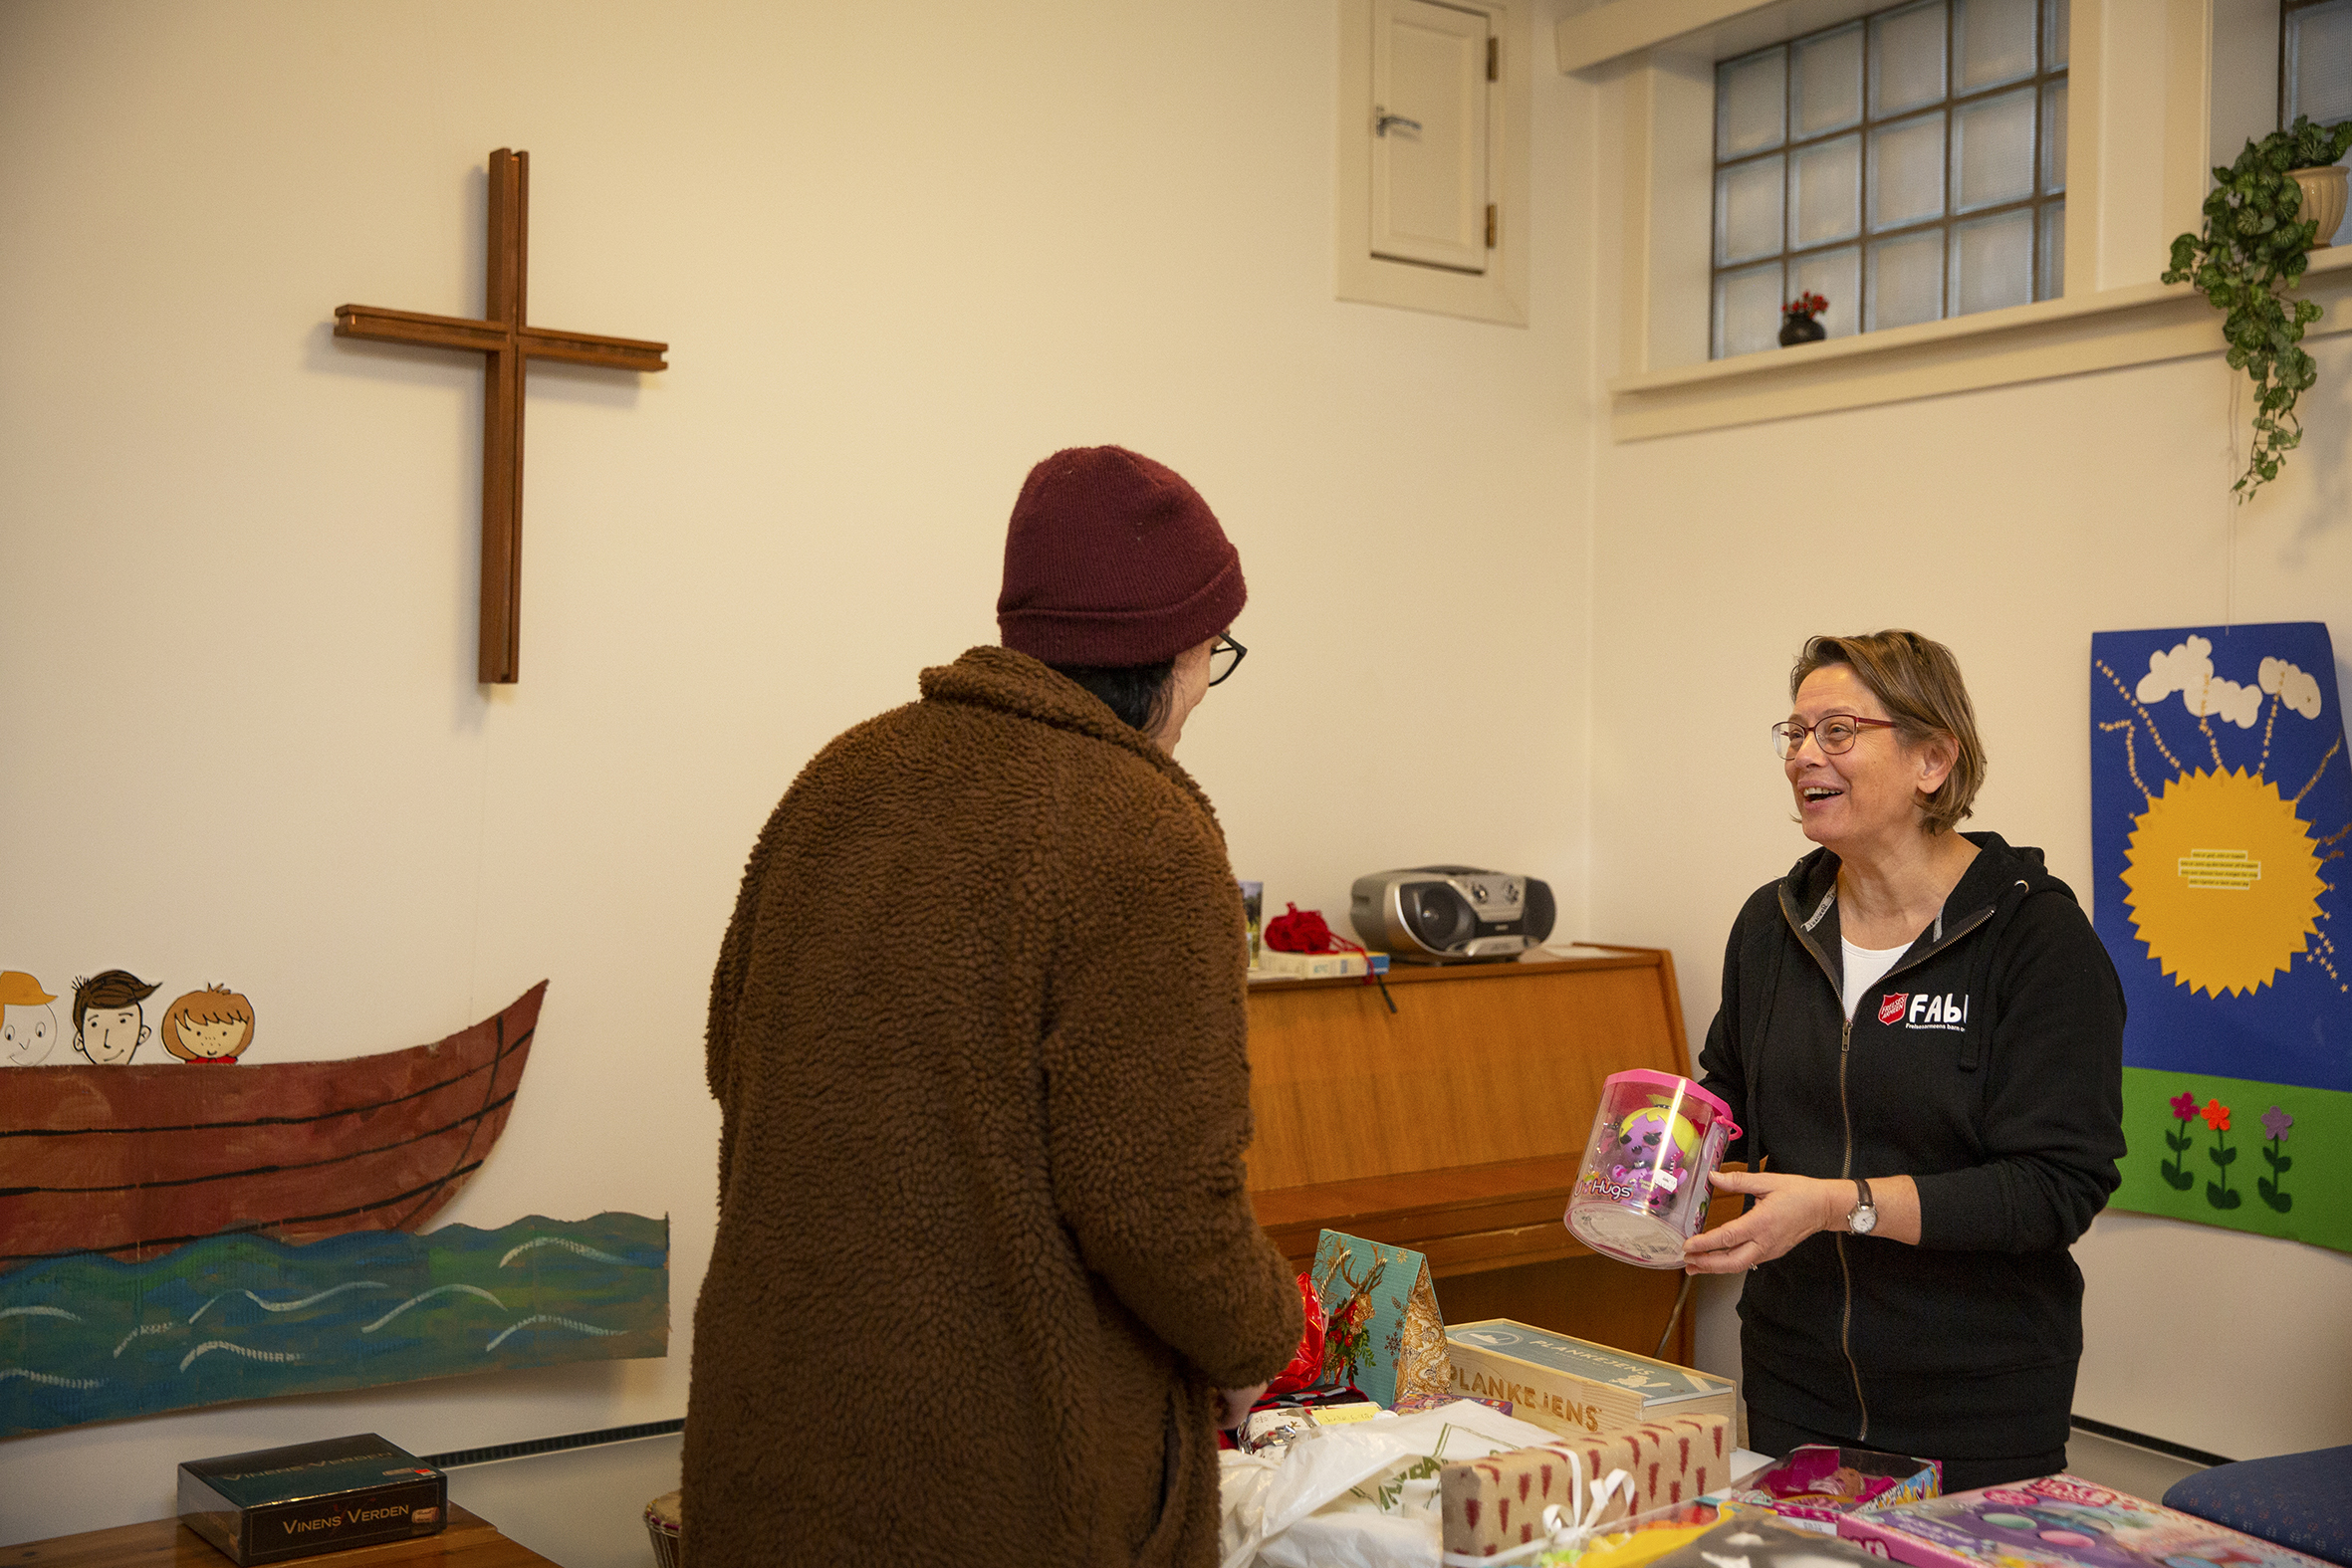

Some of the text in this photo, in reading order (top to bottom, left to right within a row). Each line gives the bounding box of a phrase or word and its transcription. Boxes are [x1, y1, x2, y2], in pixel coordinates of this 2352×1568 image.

[1909, 993, 1970, 1023] FAb
[1591, 1178, 1633, 1201] Hugs
[1529, 1339, 1655, 1375] PLANKEJENS
[283, 1516, 342, 1534] VINENS
[347, 1504, 409, 1524] VERDEN
